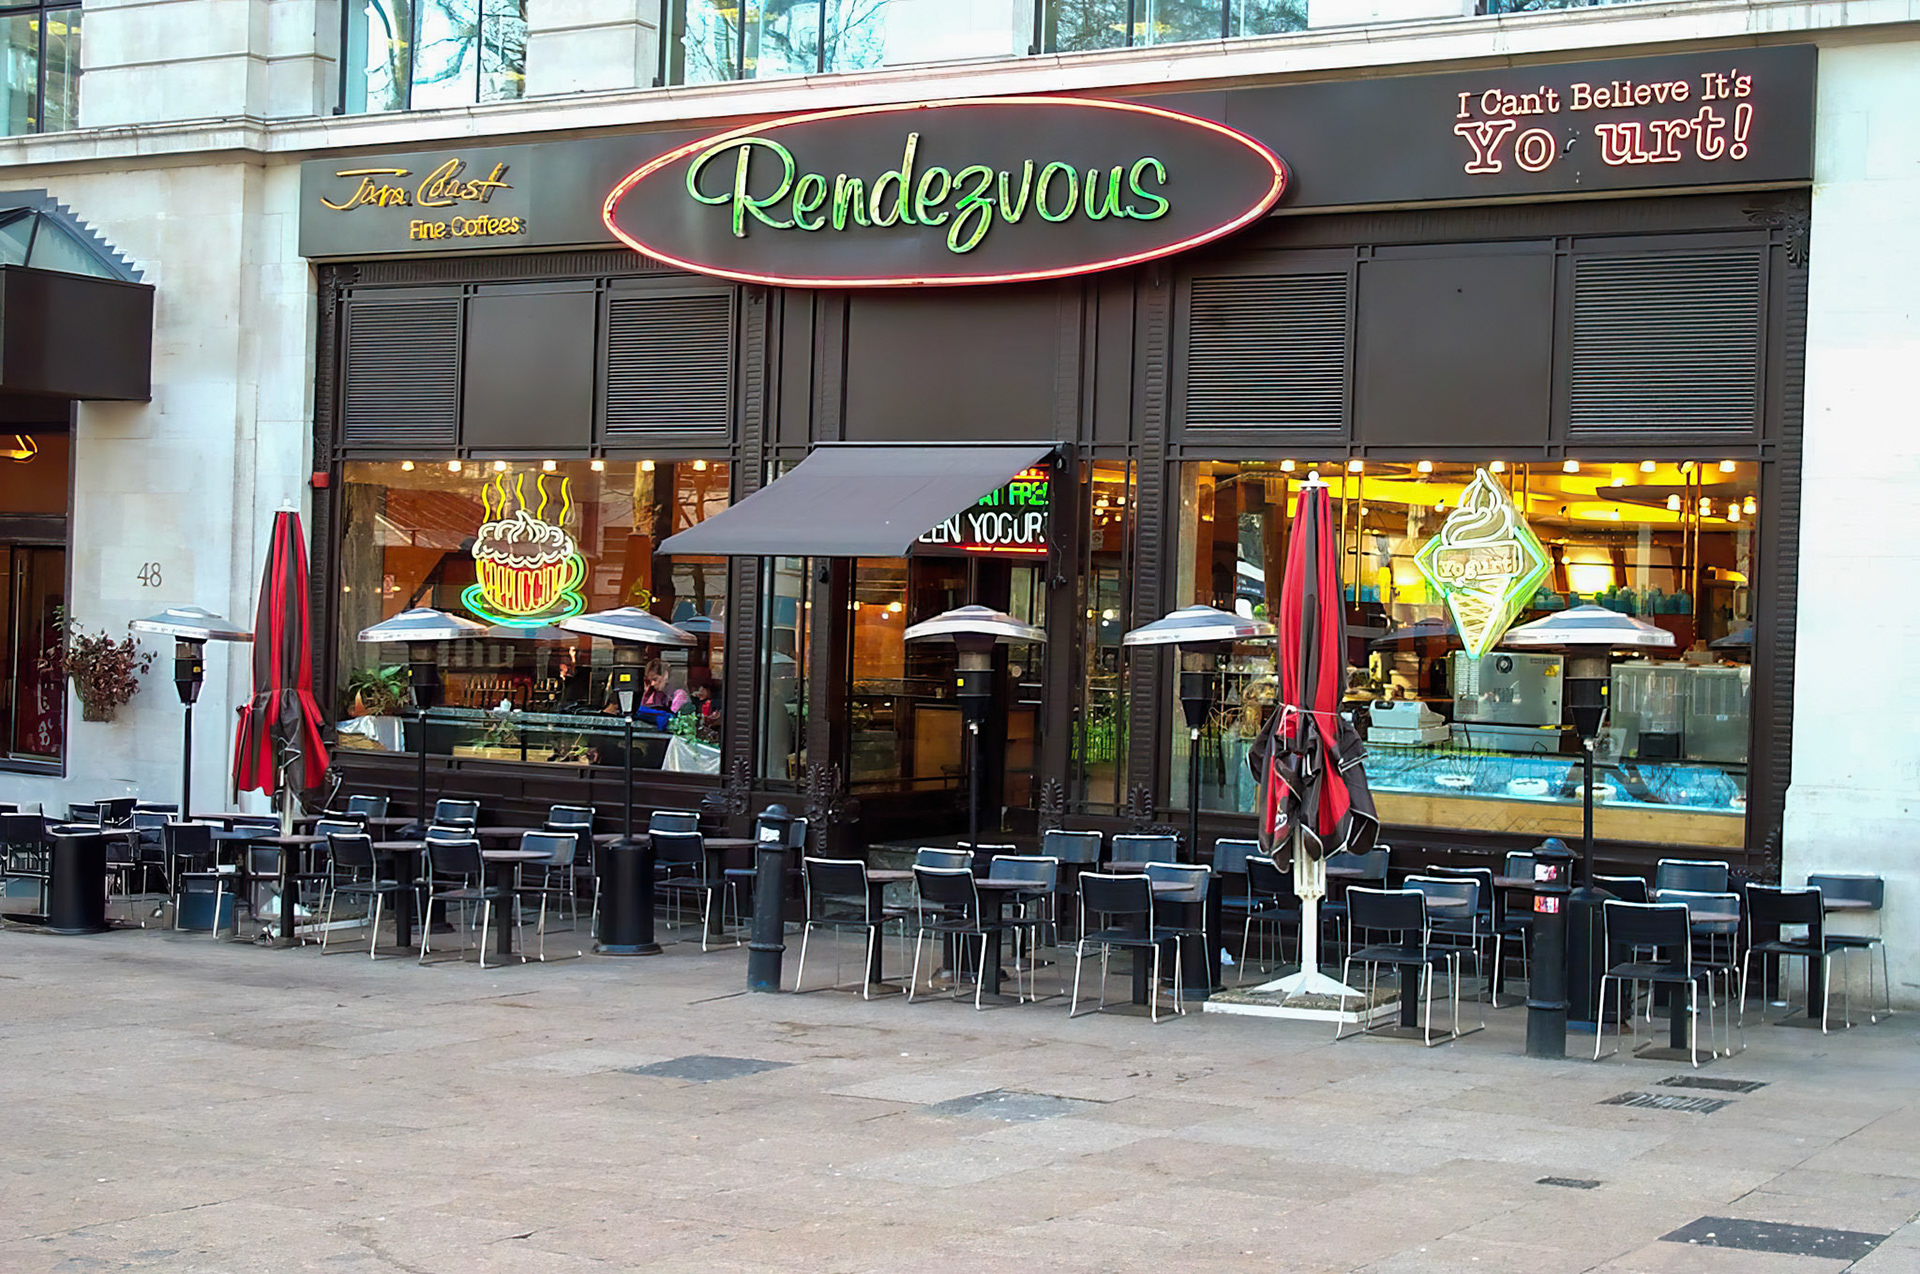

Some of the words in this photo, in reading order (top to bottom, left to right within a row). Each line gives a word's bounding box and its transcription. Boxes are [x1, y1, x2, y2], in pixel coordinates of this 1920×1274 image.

[1457, 92, 1471, 118] I
[1481, 85, 1560, 116] Can't
[1569, 79, 1690, 111] Believe
[1701, 69, 1752, 101] It's
[416, 157, 509, 207] Coast
[686, 132, 1170, 254] Rendezvous
[410, 219, 447, 239] Fine
[451, 214, 520, 237] Coffees
[918, 513, 961, 543] EN
[968, 511, 1049, 544] YOGUR
[137, 562, 162, 587] 48
